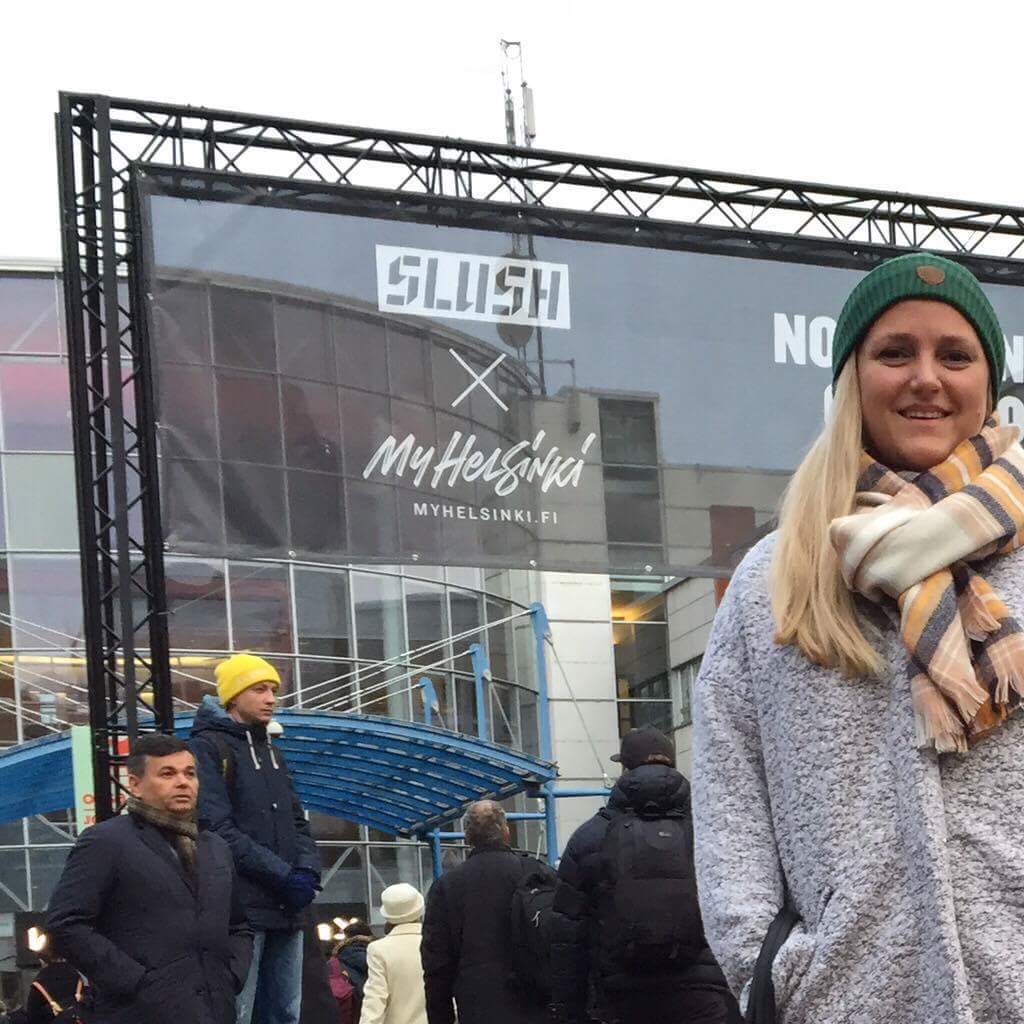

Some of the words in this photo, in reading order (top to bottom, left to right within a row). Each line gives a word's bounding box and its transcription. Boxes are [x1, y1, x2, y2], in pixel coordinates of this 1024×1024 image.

[386, 255, 561, 321] SLUSH
[1001, 334, 1024, 383] N
[413, 502, 558, 524] MYHELSINKI.FI
